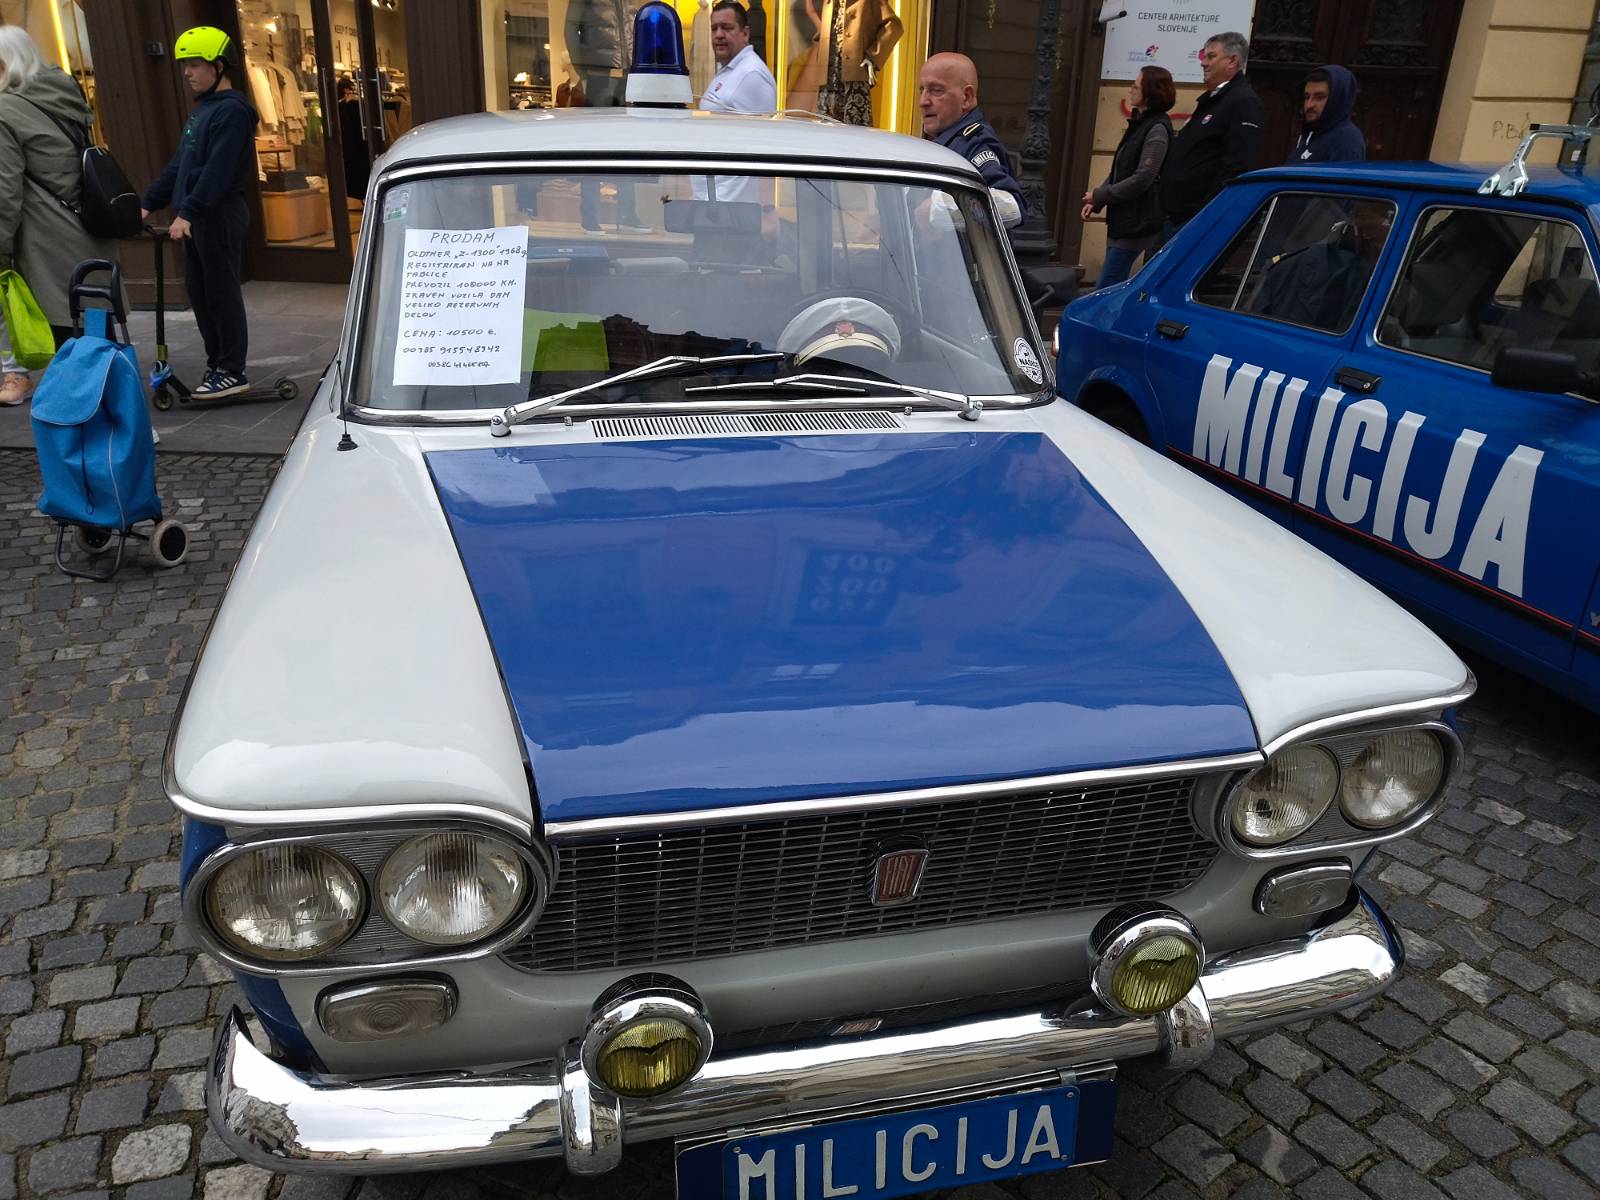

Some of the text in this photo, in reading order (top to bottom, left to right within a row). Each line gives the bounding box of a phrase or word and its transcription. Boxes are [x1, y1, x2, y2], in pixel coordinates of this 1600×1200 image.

[1138, 11, 1220, 23] CENTER ARHITEKTURE
[1157, 24, 1199, 34] SLOVENIJE
[974, 150, 995, 165] MILIC
[430, 232, 495, 244] PRODAM
[1193, 354, 1544, 598] MILICIJA
[882, 855, 917, 896] FIAT
[738, 1104, 1060, 1200] MILICIJA
